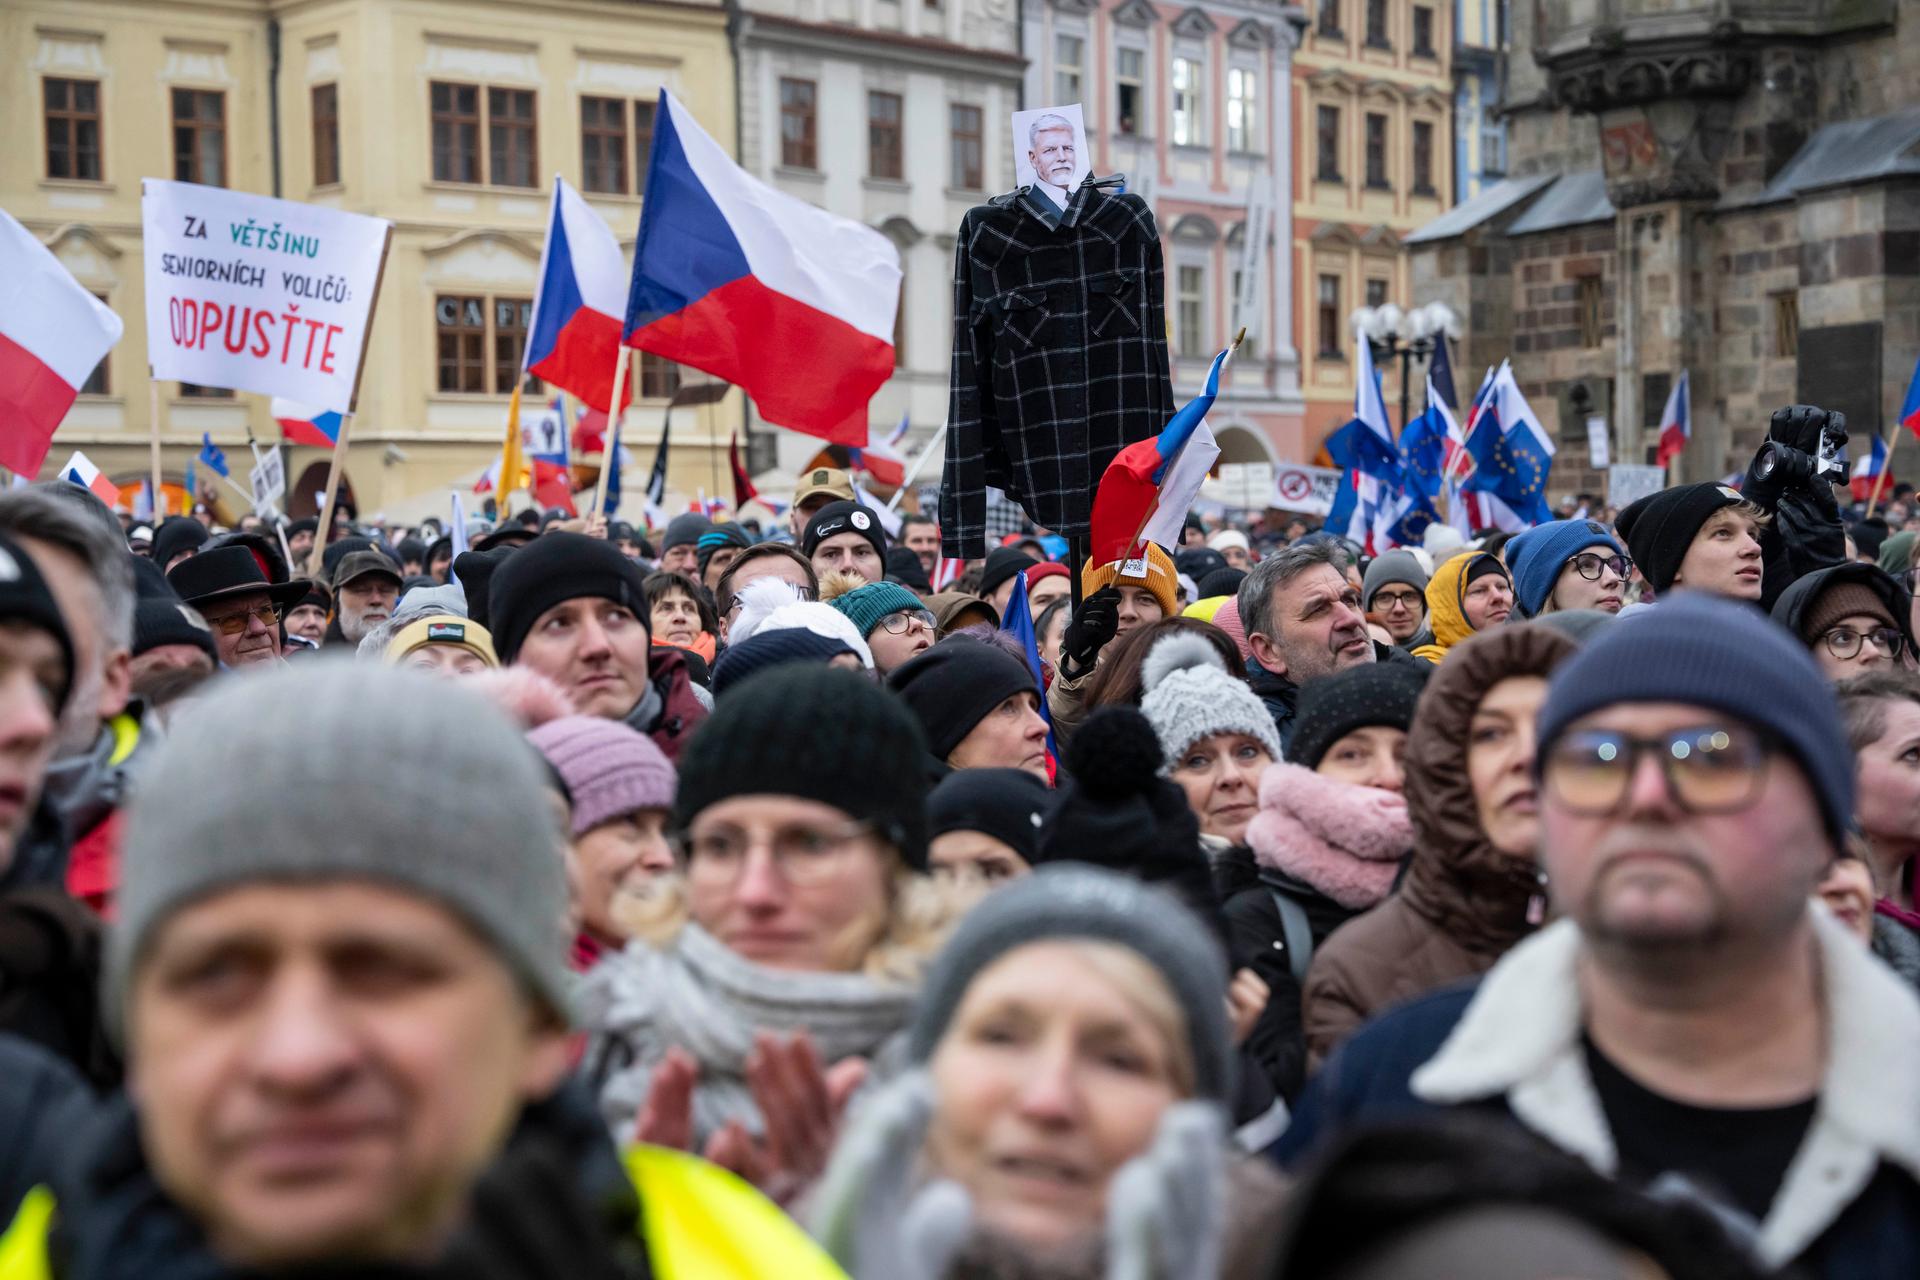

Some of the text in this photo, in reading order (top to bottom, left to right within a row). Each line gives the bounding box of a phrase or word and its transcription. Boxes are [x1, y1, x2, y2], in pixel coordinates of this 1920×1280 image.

[183, 215, 320, 259] ZA VĚTŠINU
[161, 252, 266, 288] SENIORNÍCH
[169, 296, 344, 375] ODPUSŤTE
